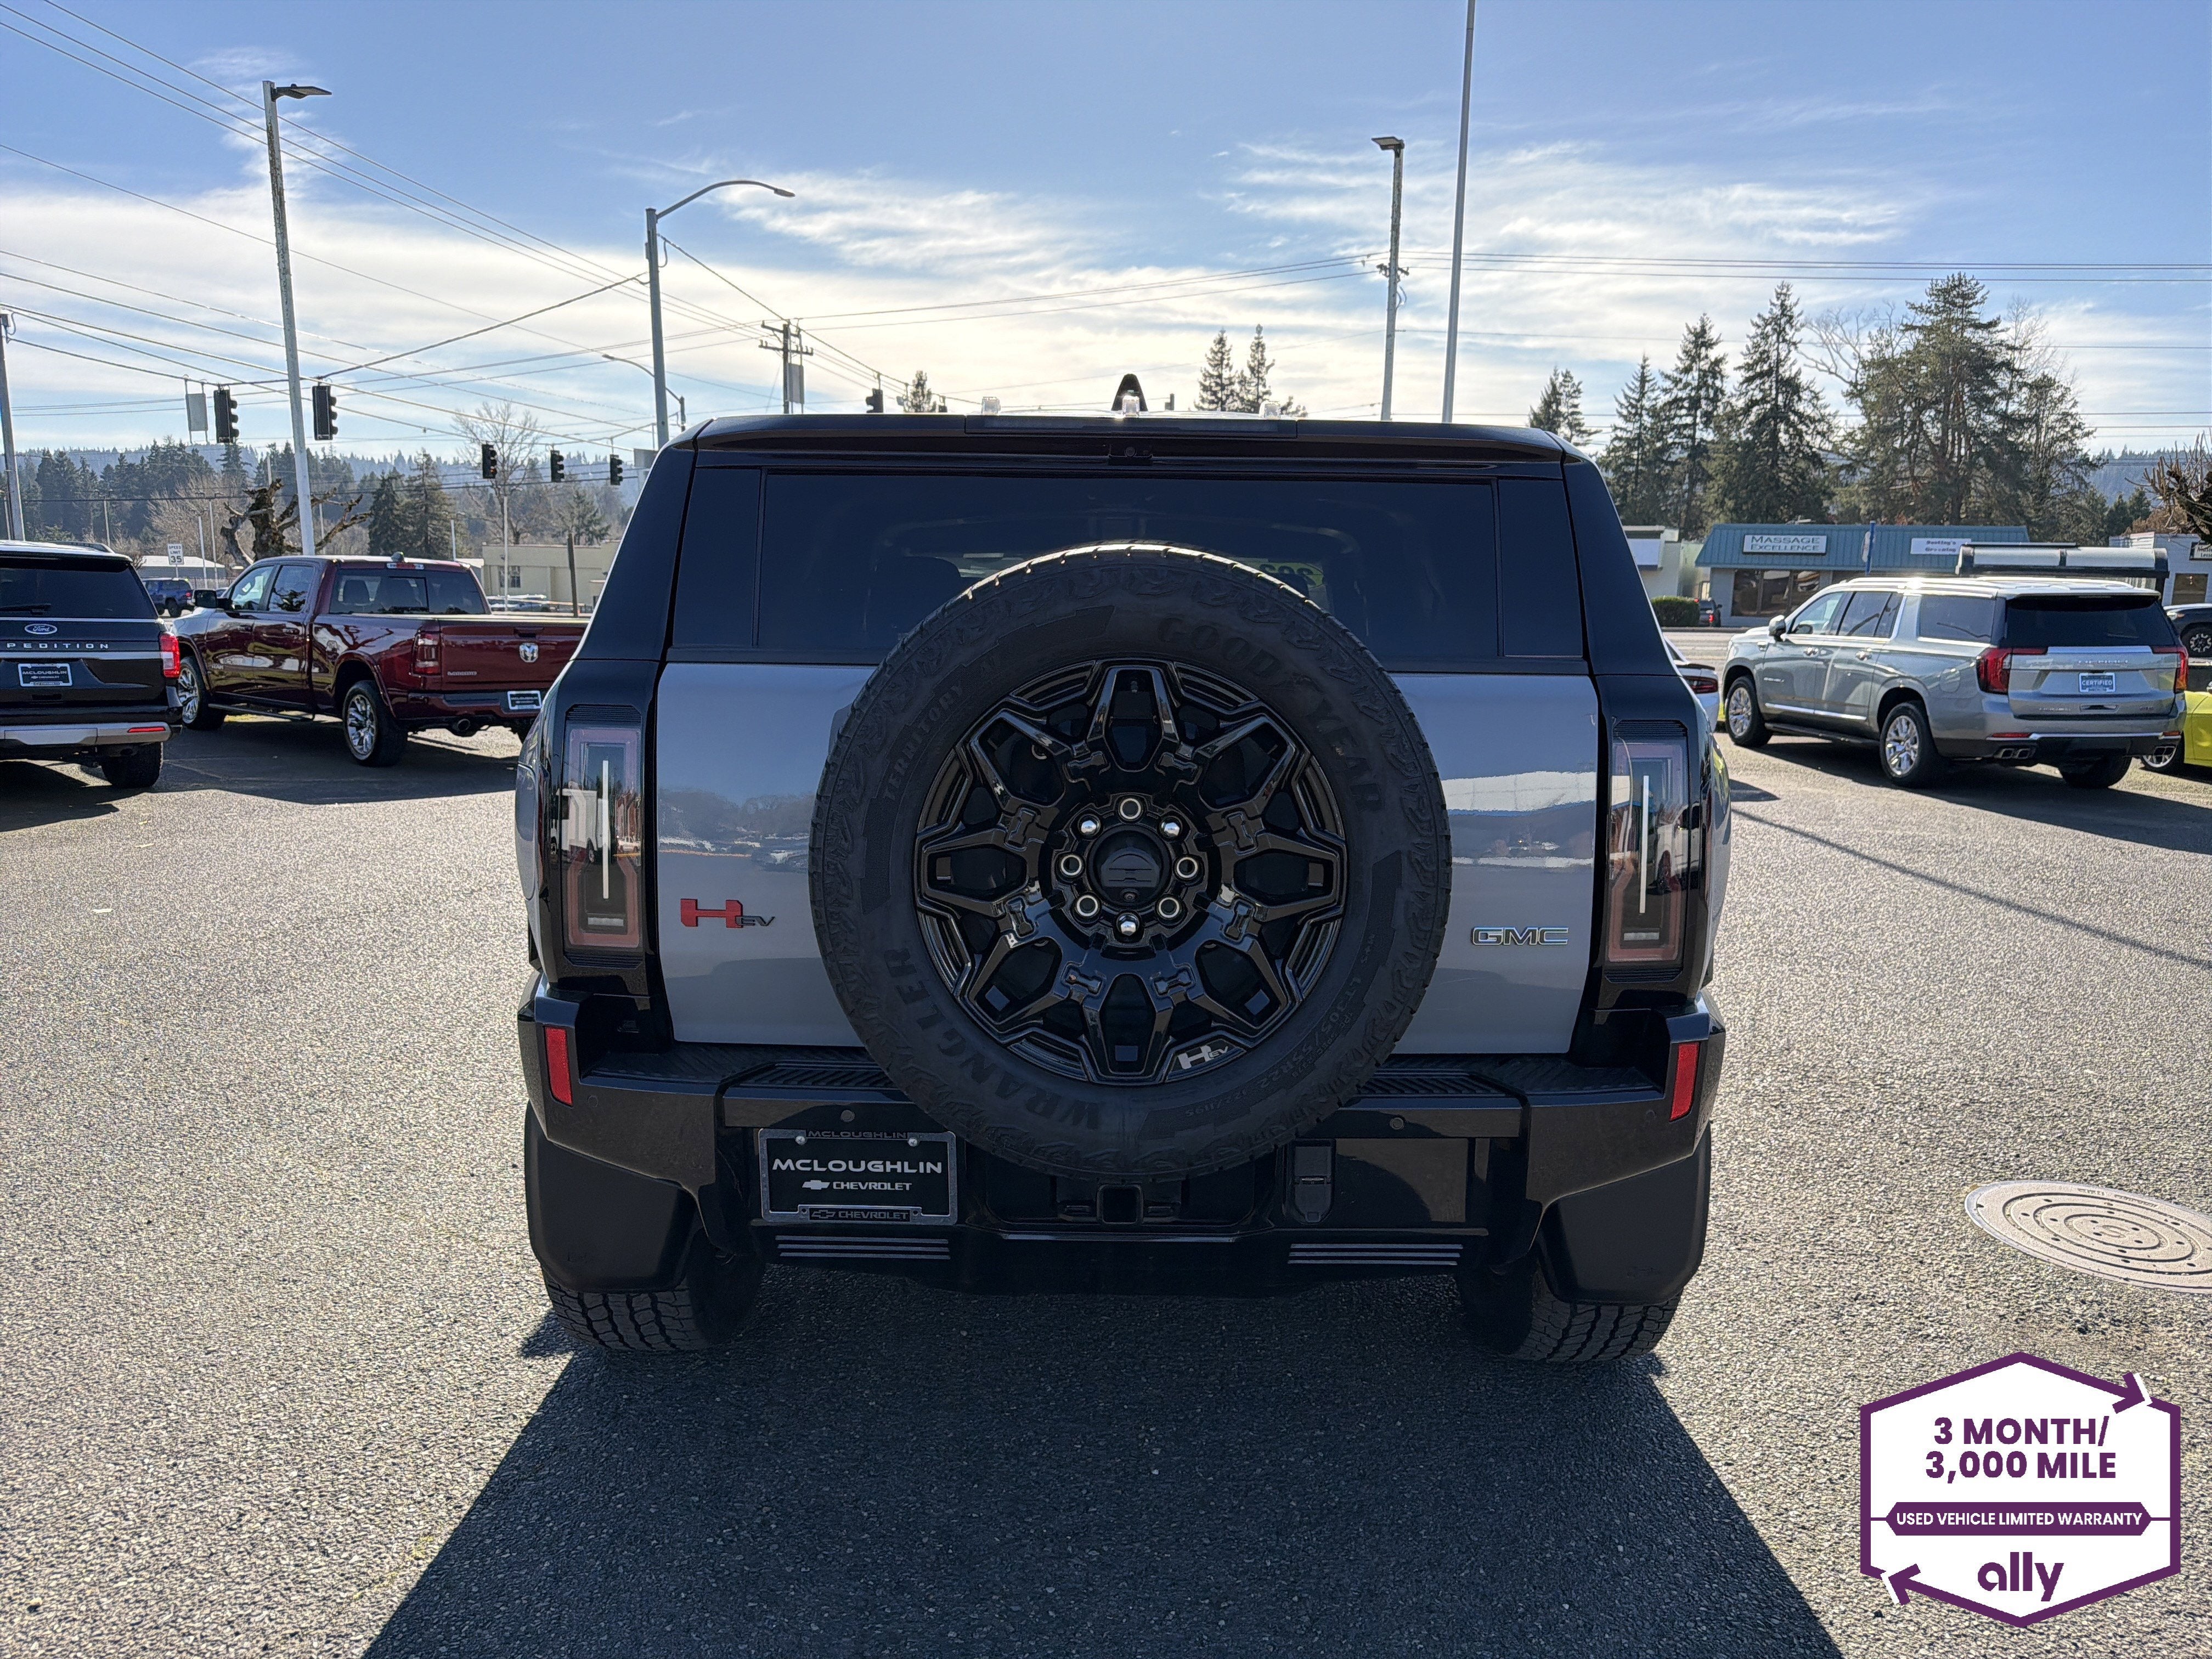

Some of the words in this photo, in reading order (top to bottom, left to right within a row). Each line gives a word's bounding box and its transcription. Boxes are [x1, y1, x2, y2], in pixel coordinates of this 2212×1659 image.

[883, 684, 964, 801] TERRITORY
[1471, 926, 1569, 945] GMC
[884, 946, 1103, 1130] WRANGLER
[808, 1131, 907, 1139] MCLOUGHLIN
[772, 1158, 943, 1173] MCLOUGHLIN
[833, 1181, 912, 1191] CHEVROLET
[838, 1210, 909, 1220] CHEVROLET
